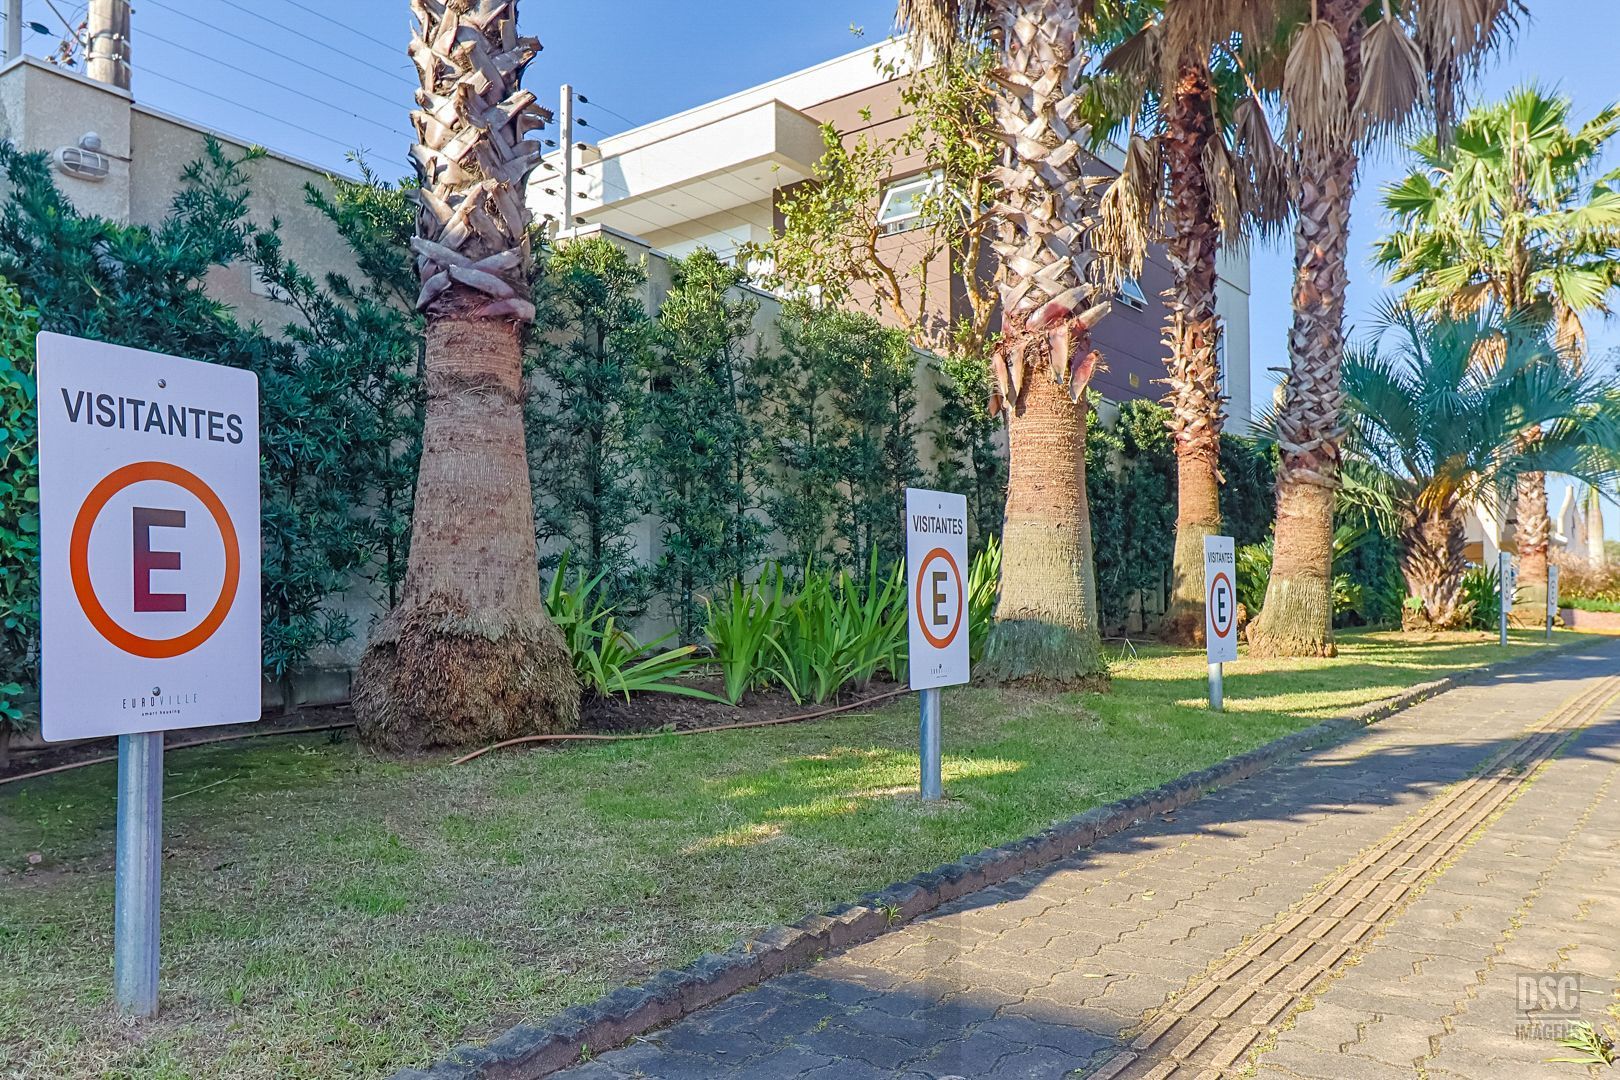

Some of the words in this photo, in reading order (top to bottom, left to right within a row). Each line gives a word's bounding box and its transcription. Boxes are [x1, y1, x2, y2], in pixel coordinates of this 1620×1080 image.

[61, 387, 244, 445] VISITANTES
[913, 514, 963, 535] VISITANTES
[133, 506, 186, 612] E
[1207, 551, 1233, 564] VISITANTES
[932, 571, 948, 625] E
[1218, 587, 1226, 622] E
[122, 693, 198, 709] EUROVILLE
